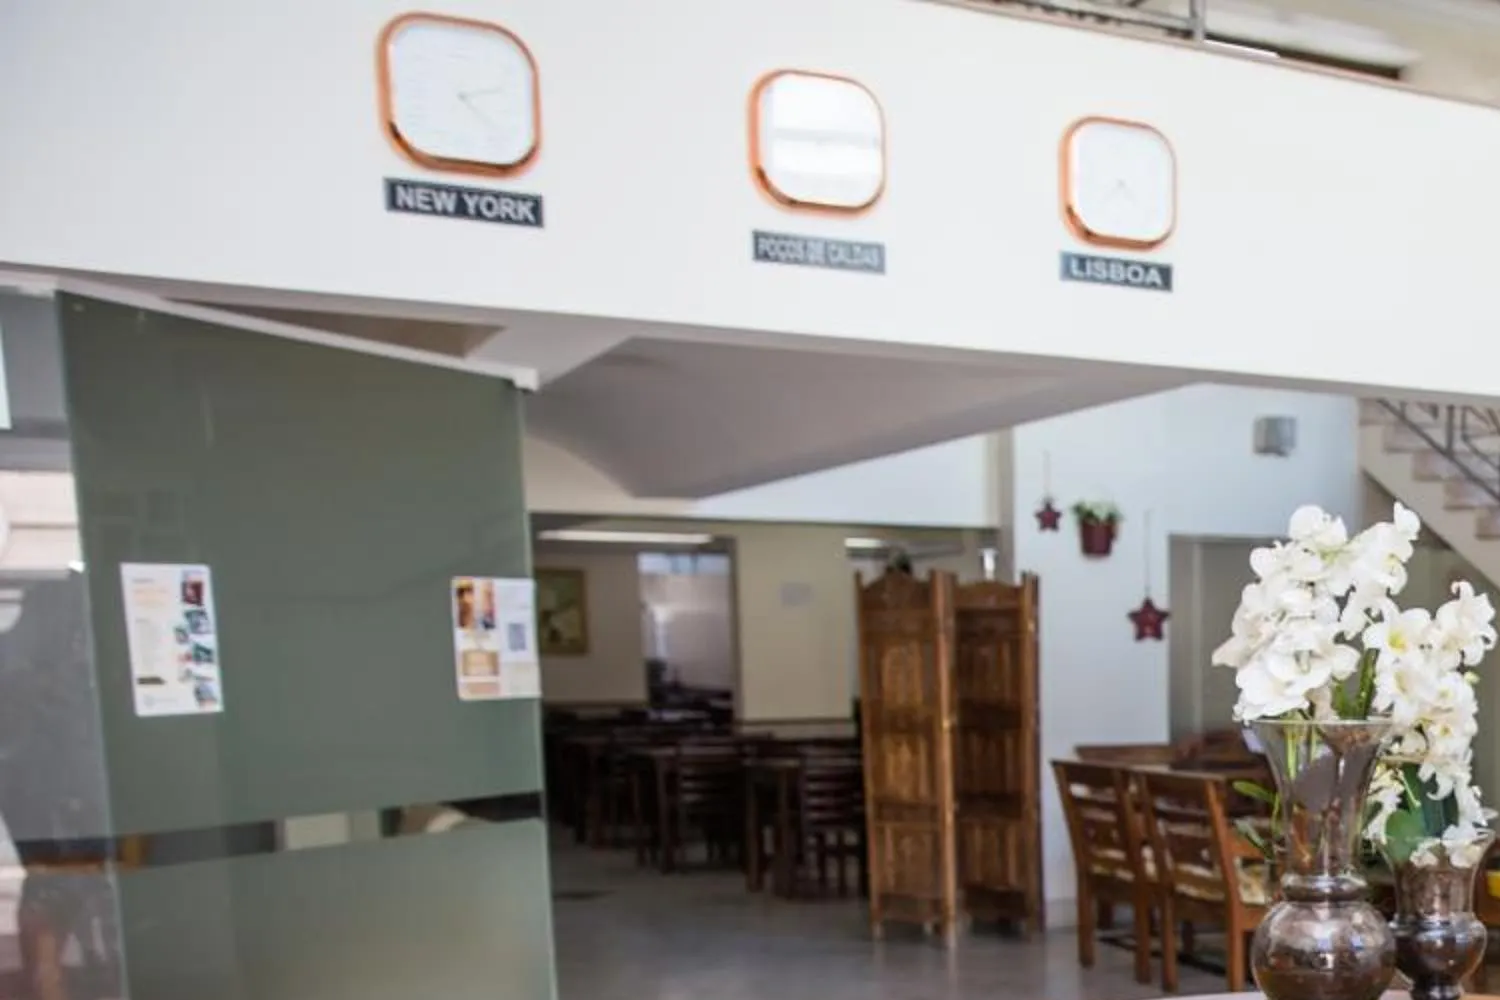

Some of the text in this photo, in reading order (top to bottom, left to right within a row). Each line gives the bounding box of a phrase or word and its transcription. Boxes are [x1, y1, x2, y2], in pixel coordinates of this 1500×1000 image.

[396, 184, 536, 223] NEW YORK
[1071, 256, 1163, 286] LISBOA
